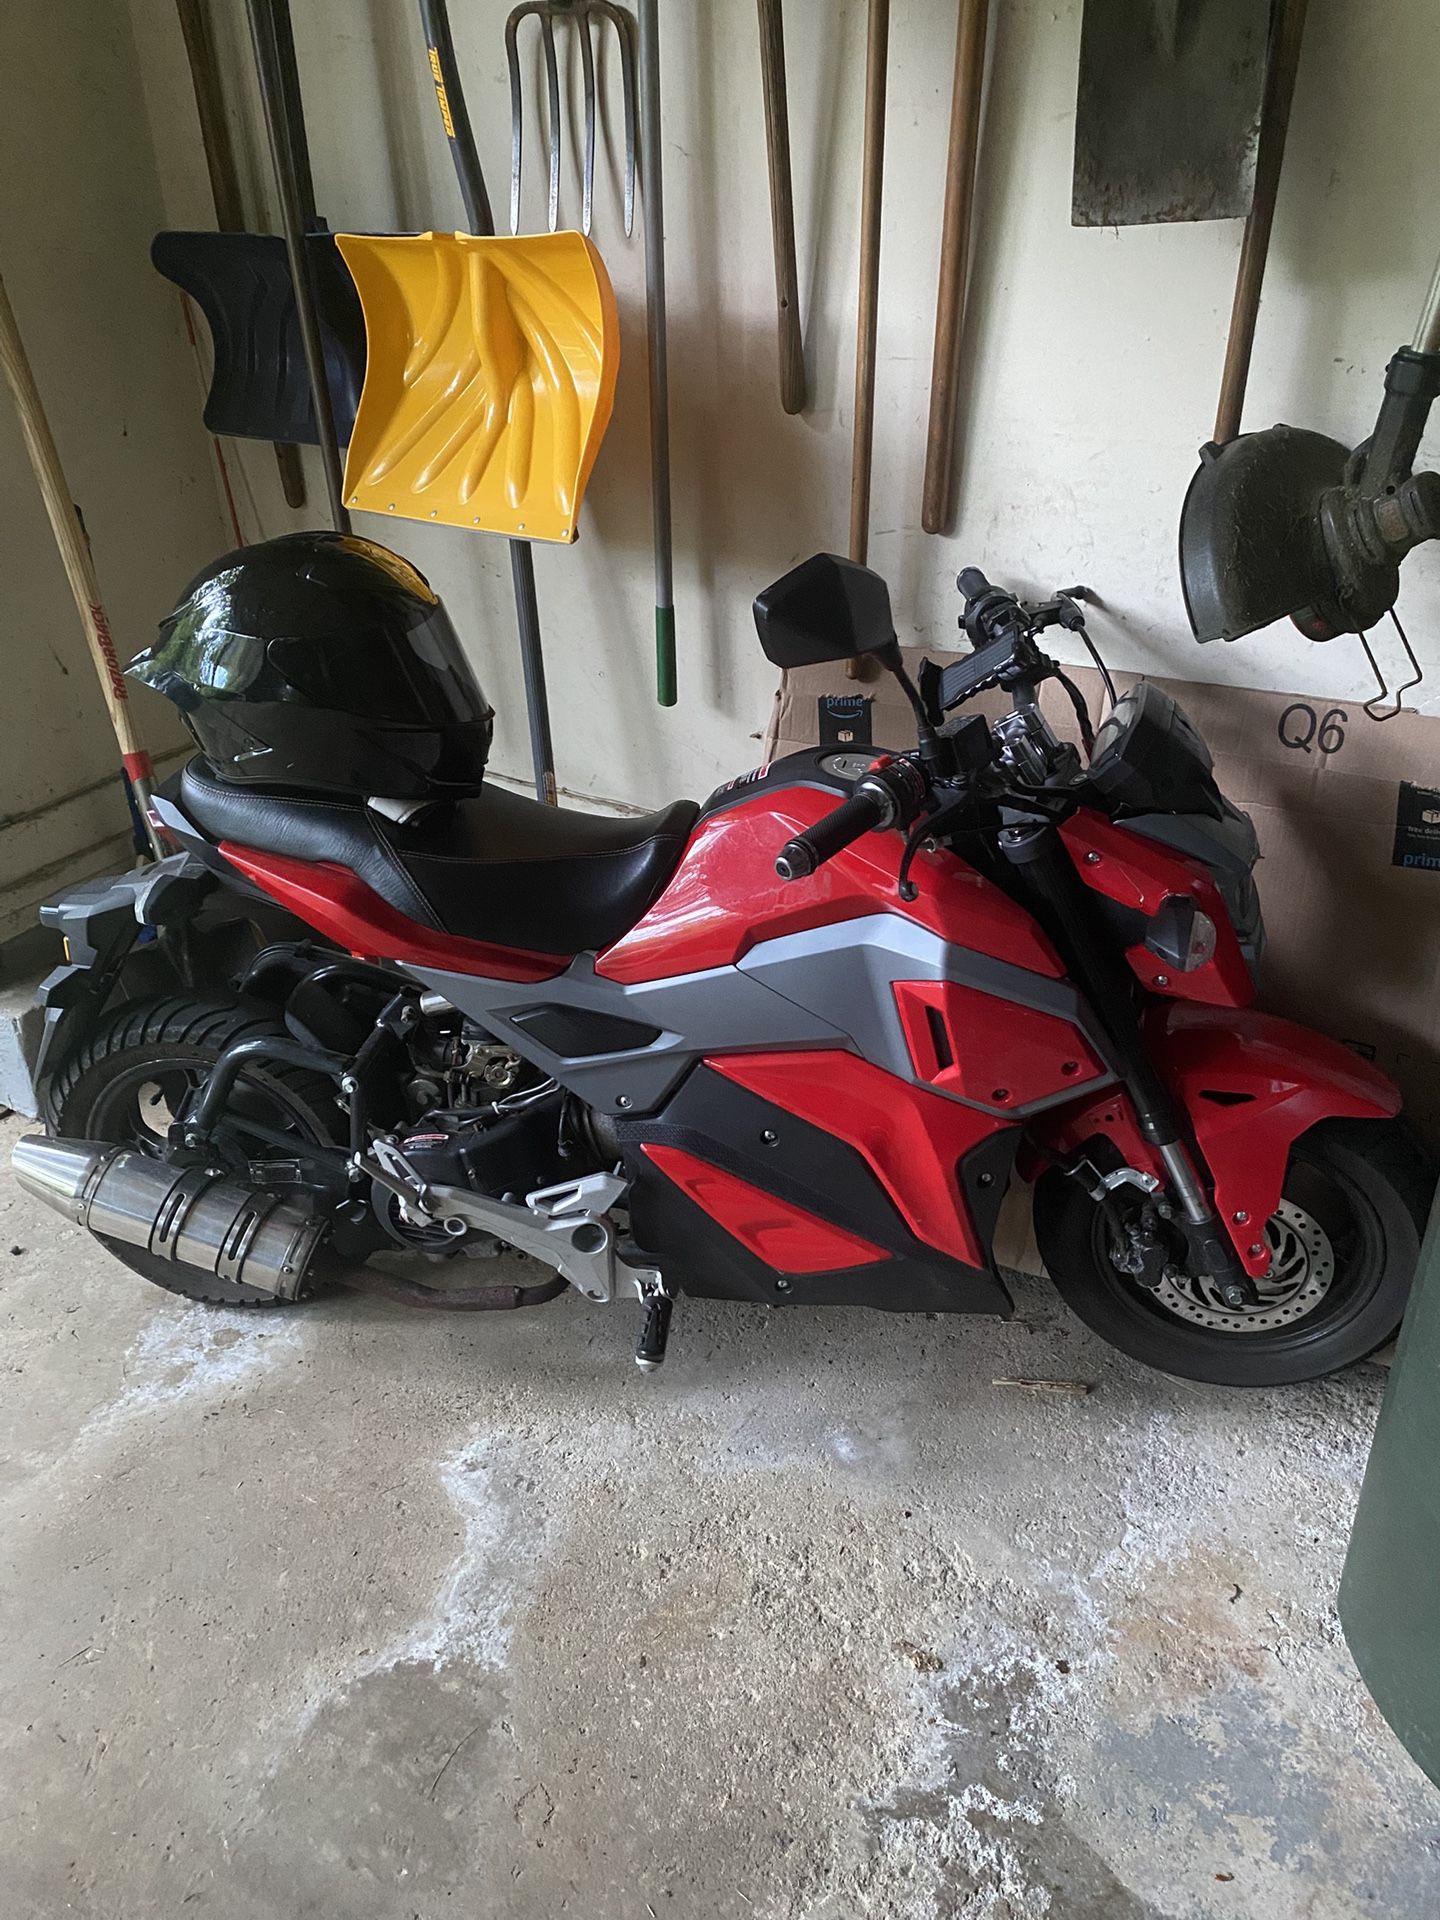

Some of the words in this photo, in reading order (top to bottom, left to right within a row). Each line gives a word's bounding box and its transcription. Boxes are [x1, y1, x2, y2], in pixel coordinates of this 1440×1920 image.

[428, 47, 444, 83] TRUE
[826, 697, 864, 709] prime
[1278, 703, 1348, 754] Q6
